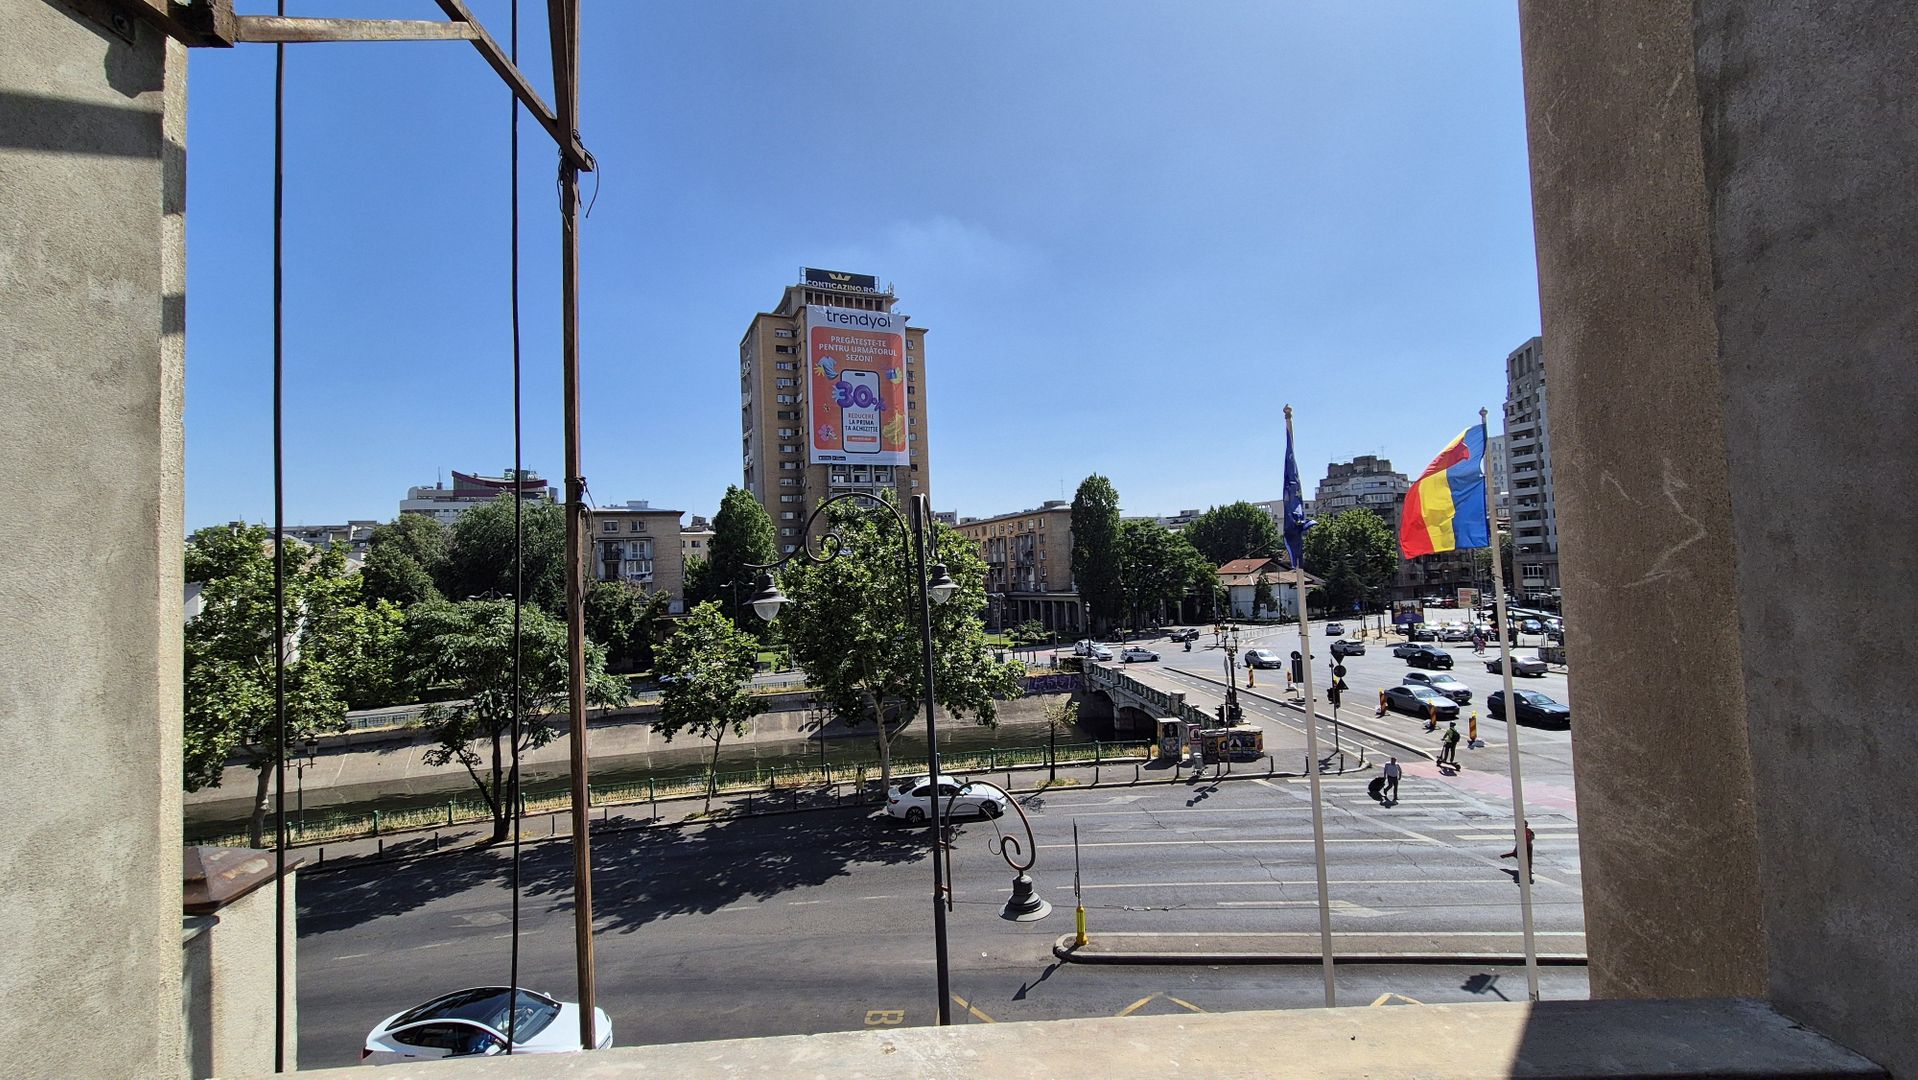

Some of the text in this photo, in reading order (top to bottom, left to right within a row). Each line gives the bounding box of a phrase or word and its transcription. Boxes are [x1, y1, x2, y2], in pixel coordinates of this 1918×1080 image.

[826, 309, 891, 329] trendyol
[818, 343, 897, 357] PENTRU URMĂTORUL
[835, 381, 886, 412] 30%
